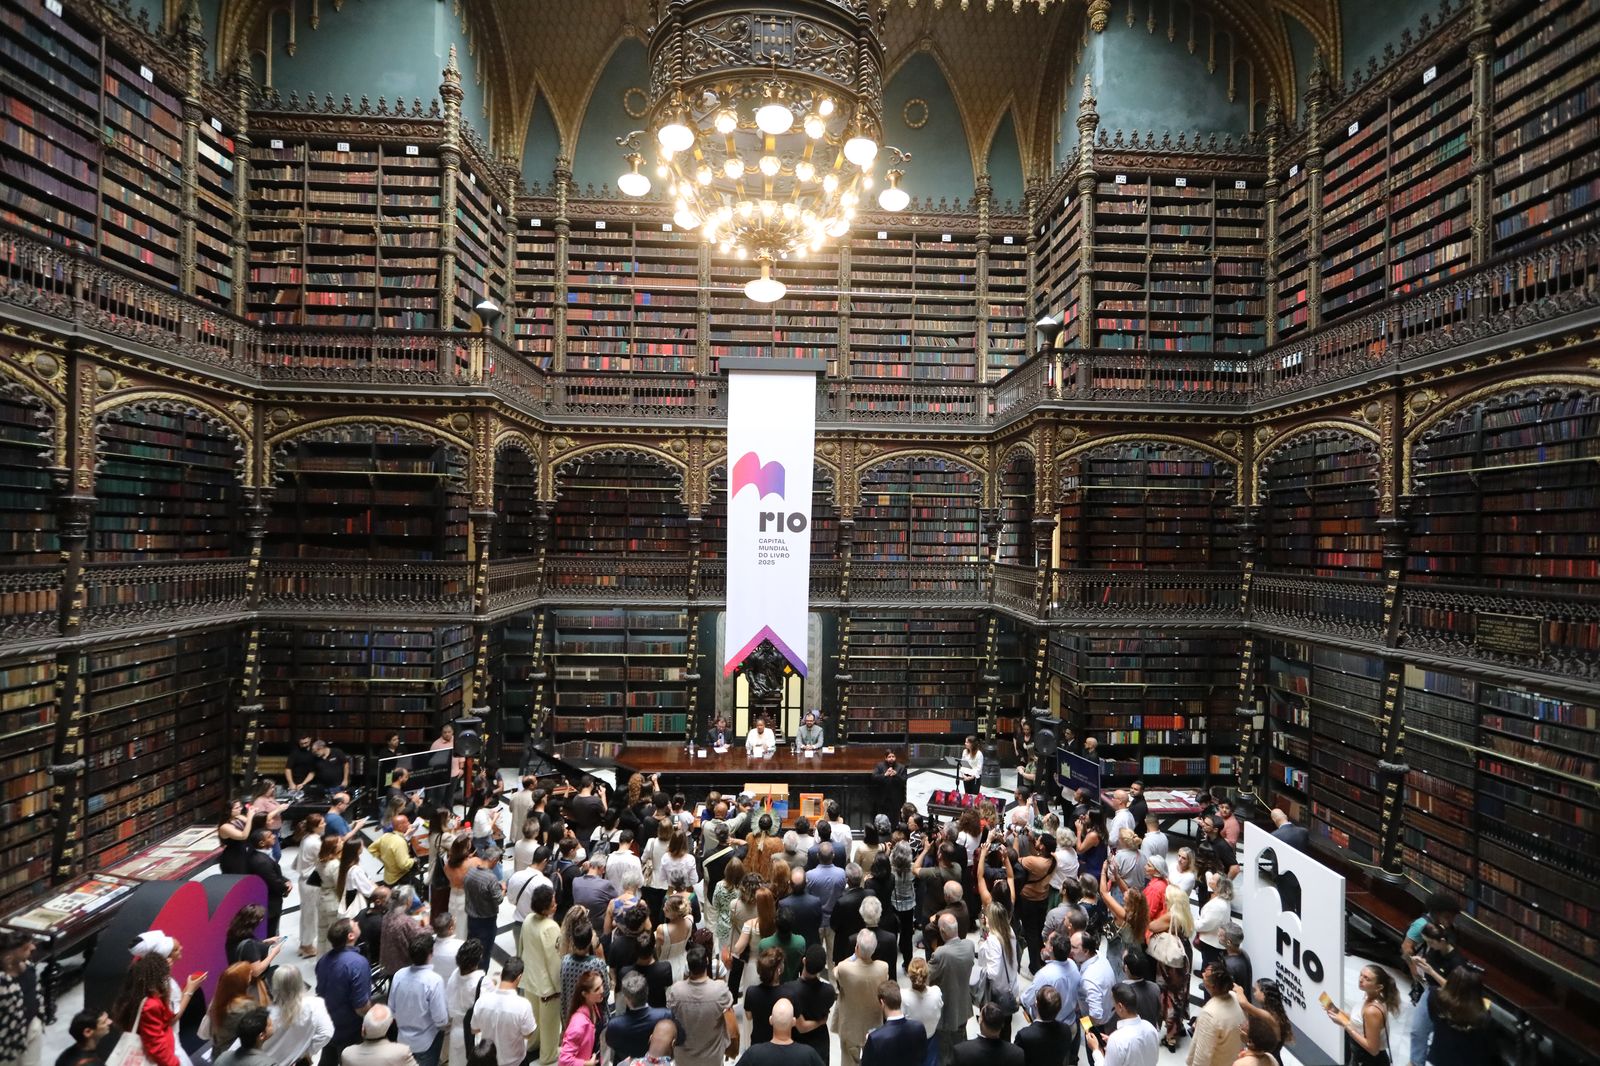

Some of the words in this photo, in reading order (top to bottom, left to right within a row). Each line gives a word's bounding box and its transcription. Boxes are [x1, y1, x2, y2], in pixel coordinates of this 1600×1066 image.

[1276, 961, 1302, 987] CAPITAL
[1276, 970, 1305, 999] MUNDIAL
[1286, 987, 1307, 1010] LIVRO
